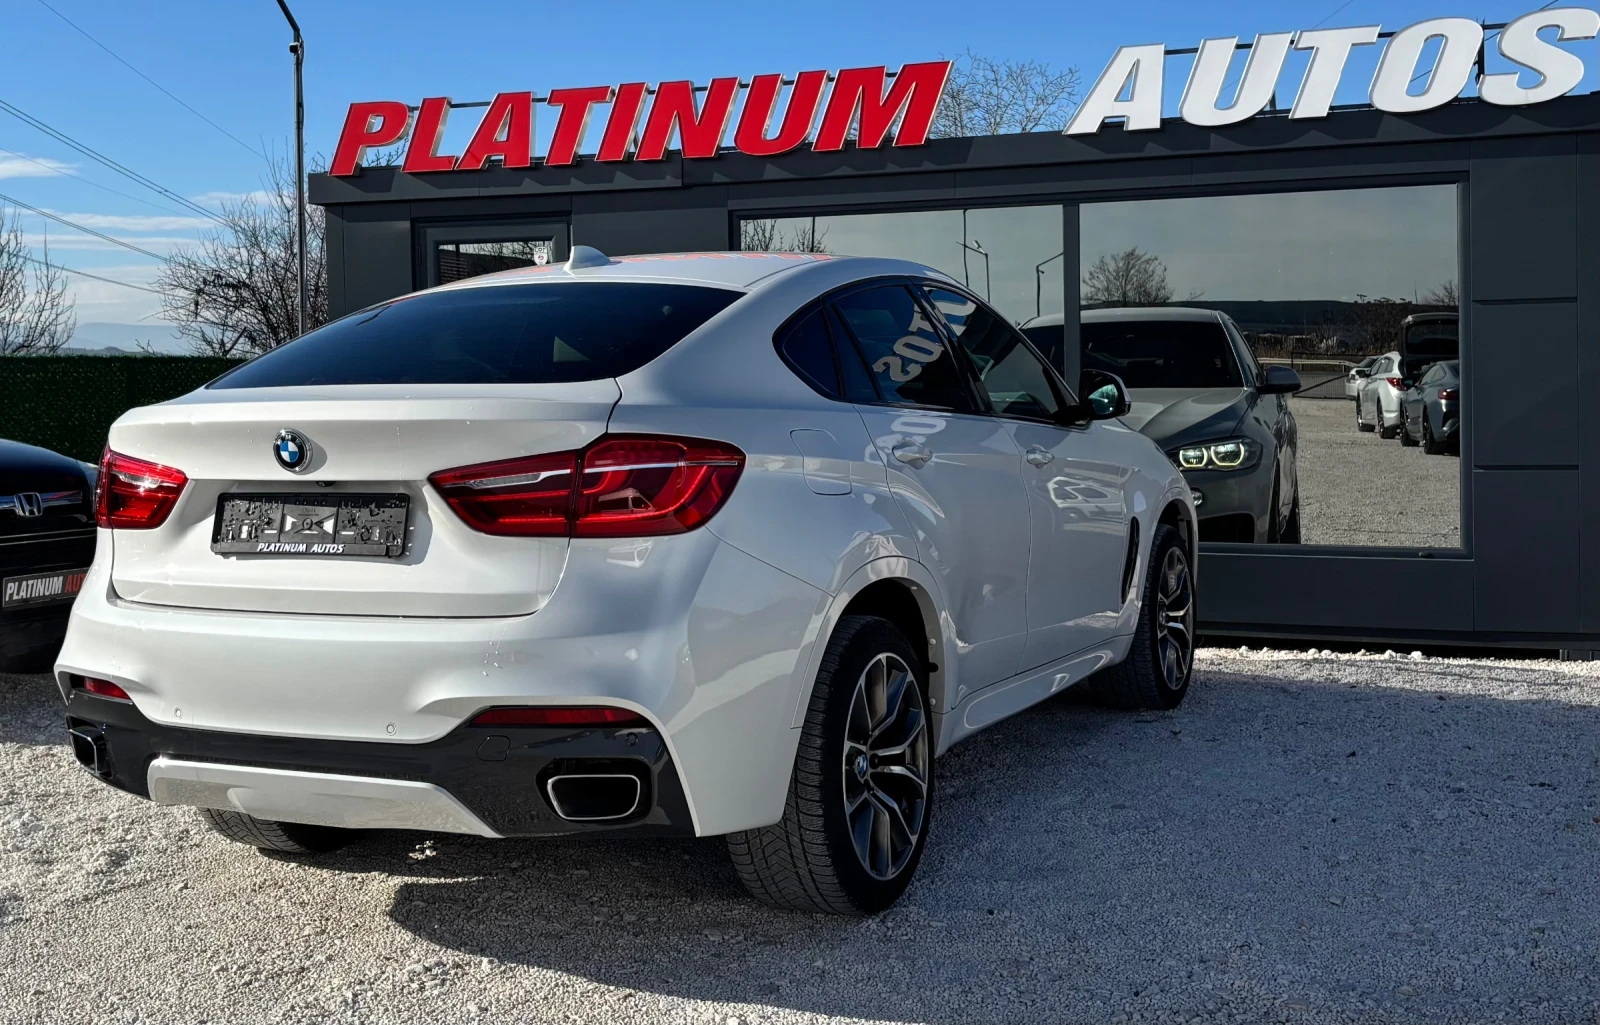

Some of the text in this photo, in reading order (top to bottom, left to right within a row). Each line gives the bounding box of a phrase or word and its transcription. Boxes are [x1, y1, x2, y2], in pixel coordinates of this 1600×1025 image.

[328, 7, 1600, 176] PLATINUM AUTOS
[257, 543, 344, 553] PLATINUM AUTOS
[6, 576, 64, 602] PLATINUM
